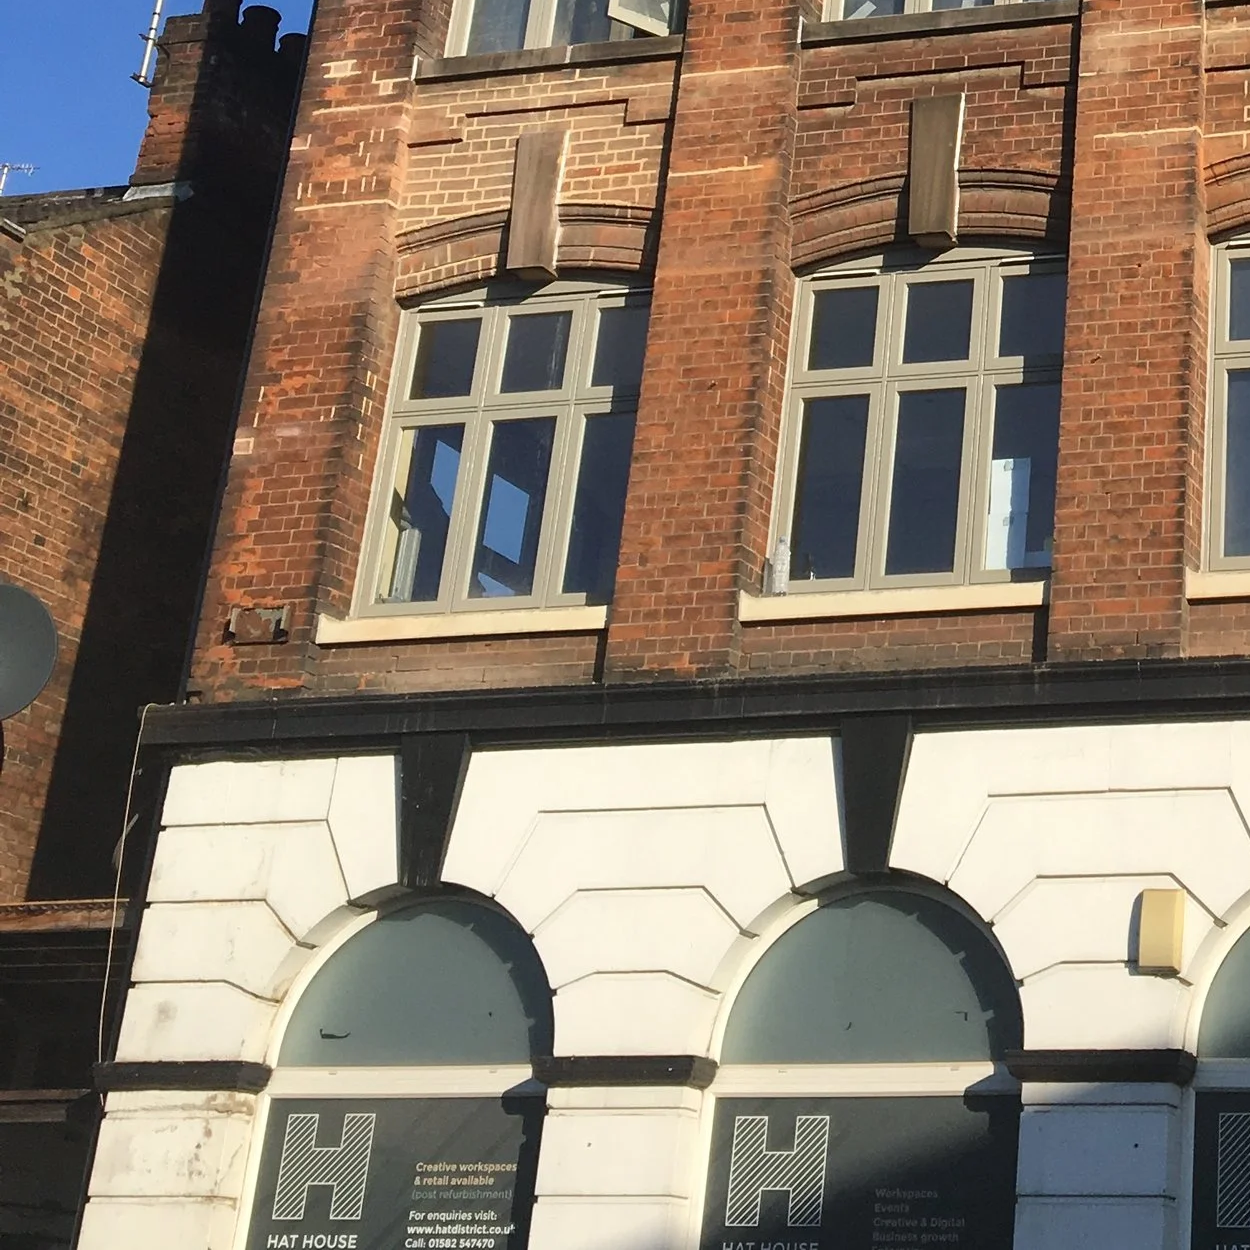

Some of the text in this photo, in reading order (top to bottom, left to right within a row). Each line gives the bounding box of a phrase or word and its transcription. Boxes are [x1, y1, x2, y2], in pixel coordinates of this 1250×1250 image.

[272, 1113, 376, 1220] H
[416, 1161, 517, 1174] Creative workspaces
[725, 1115, 830, 1227] H
[414, 1175, 495, 1186] & retail available
[411, 1189, 513, 1200] (post refurbishment)
[875, 1187, 938, 1199] Workspaces
[874, 1202, 910, 1213] Events
[408, 1210, 498, 1222] For enquiries visit:
[873, 1216, 965, 1230] Creative & Digital
[266, 1234, 358, 1249] HAT HOUSE
[405, 1238, 495, 1248] Call: 01582 547470
[920, 1232, 959, 1244] growth
